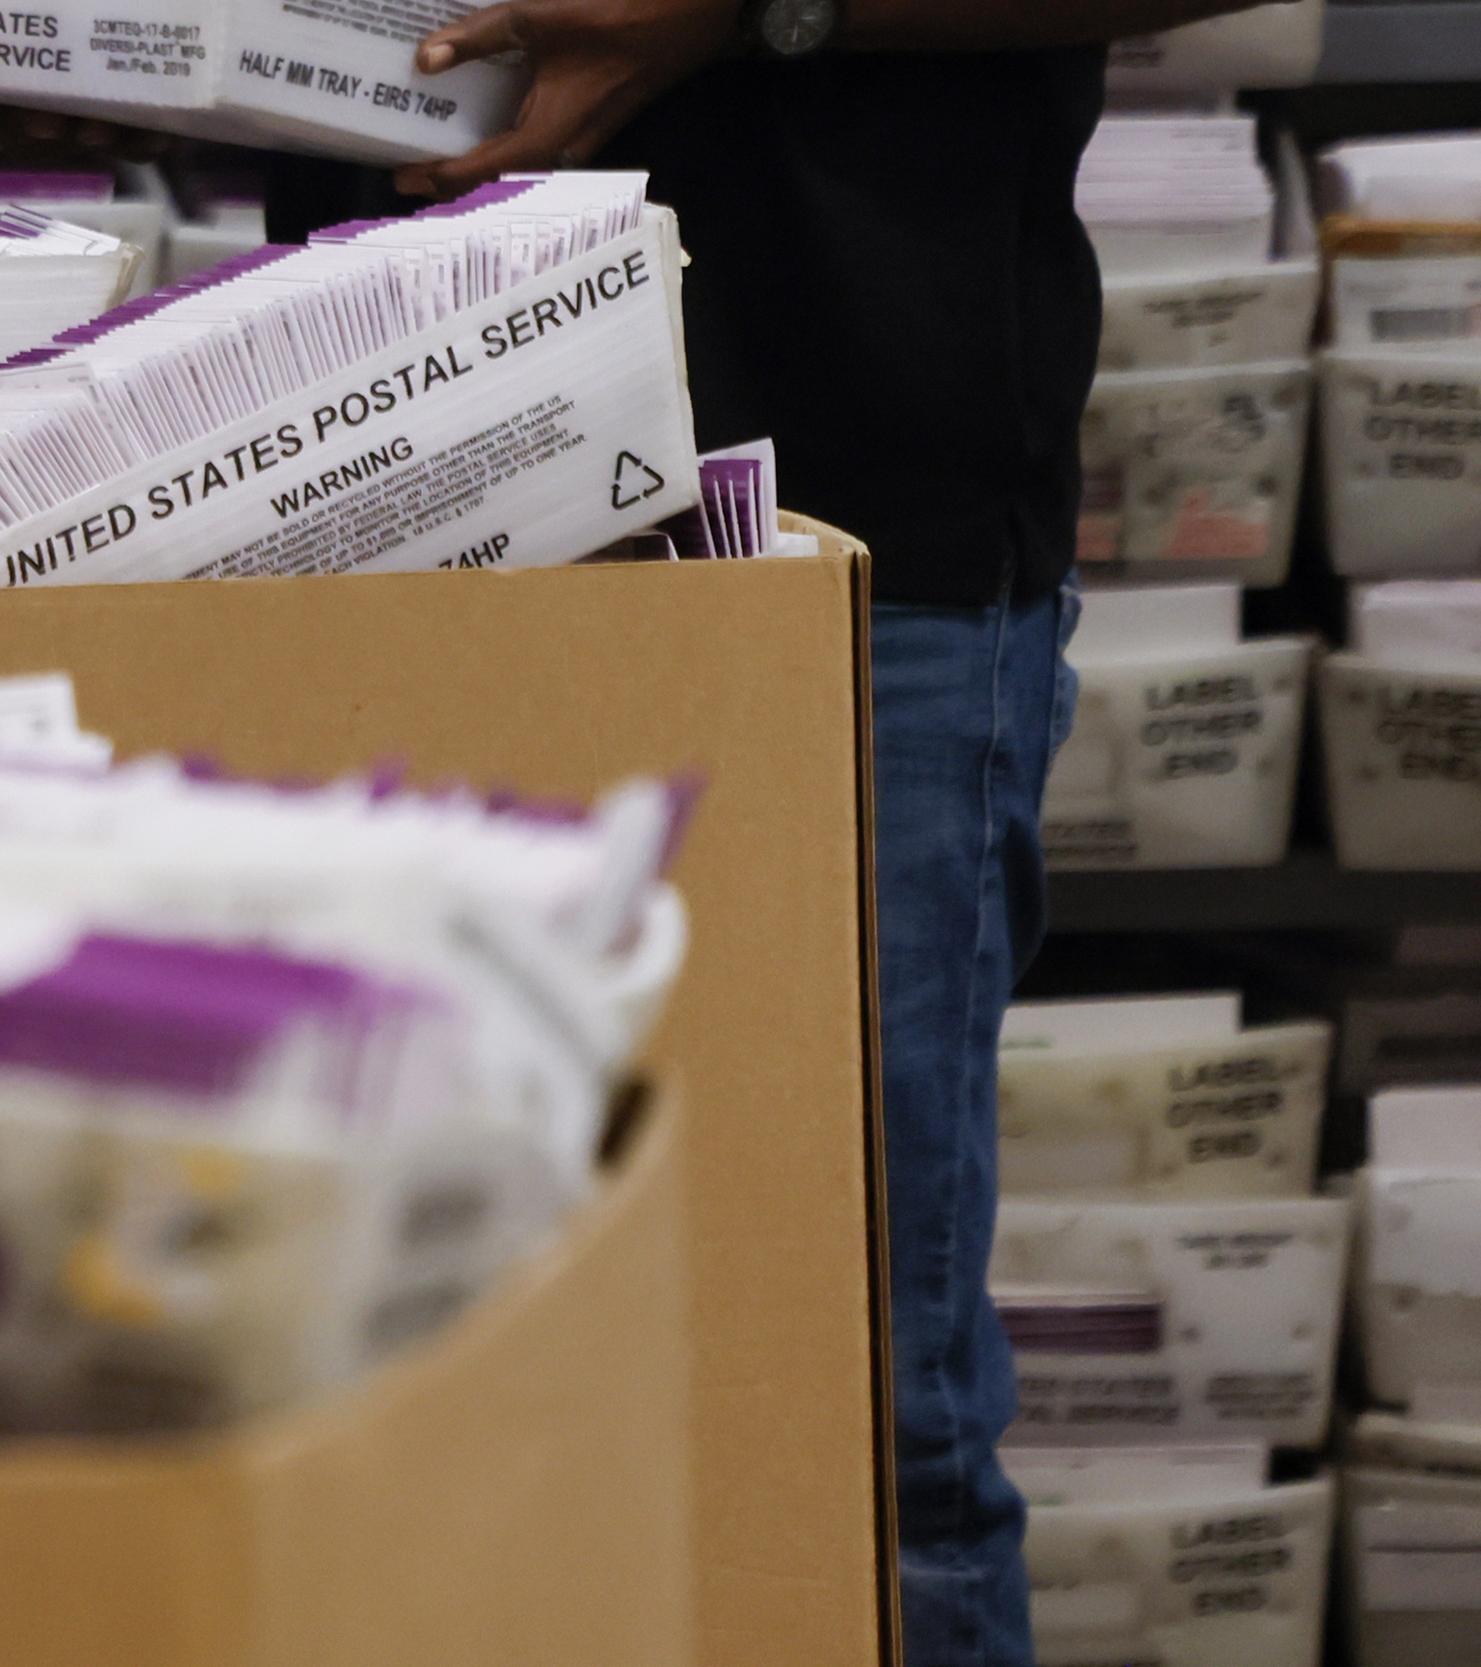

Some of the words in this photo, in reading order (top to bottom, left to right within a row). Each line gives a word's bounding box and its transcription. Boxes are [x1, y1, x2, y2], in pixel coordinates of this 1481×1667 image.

[239, 49, 285, 80] HALF
[285, 59, 314, 88] MM
[317, 68, 363, 99] TRAY
[373, 82, 412, 112] EIRS
[414, 92, 458, 122] 74HP
[148, 424, 304, 520] STATES
[312, 345, 474, 444] POSTAL
[481, 250, 650, 361] SERVICE
[221, 550, 242, 565] MAY
[243, 540, 264, 554] NOT
[266, 532, 280, 543] BE
[282, 518, 309, 536] SOLD
[311, 510, 326, 521] OR
[327, 484, 381, 514] RECYCLED
[381, 461, 427, 488] WITHOUT
[429, 451, 448, 465] THE
[449, 422, 510, 455] PERMISSION
[511, 415, 525, 426] OF
[527, 405, 546, 418] THE
[548, 395, 562, 407] US
[240, 557, 255, 569] OF
[256, 545, 279, 561] THIS
[280, 517, 337, 549] EQUIPMENT
[338, 506, 360, 522] FOR
[361, 496, 382, 511] ANY
[383, 472, 431, 500] PURPOSE
[432, 455, 467, 477] OTHER
[467, 441, 495, 460] THAN
[497, 431, 517, 446] THE
[518, 400, 575, 435] TRANSPORT
[270, 437, 415, 520] WARNING
[270, 542, 337, 578] TECHNOLOGY
[339, 534, 353, 545] TO
[354, 511, 400, 538] MONITOR
[402, 501, 421, 515] THE
[422, 476, 473, 506] LOCATION
[473, 470, 487, 481] OF
[490, 458, 512, 473] THIS
[513, 428, 568, 462] EQUIPMENT
[277, 530, 336, 563] PROHIBITED
[337, 522, 352, 534] BY
[353, 500, 398, 527] FEDERAL
[426, 478, 445, 492] THE
[447, 459, 485, 482] POSTAL
[486, 438, 527, 463] SERVICE
[530, 424, 557, 442] USES
[489, 475, 503, 487] OF
[505, 467, 520, 479] UP
[521, 459, 535, 471] TO
[535, 449, 557, 464] ONE
[558, 433, 586, 453] YEAR
